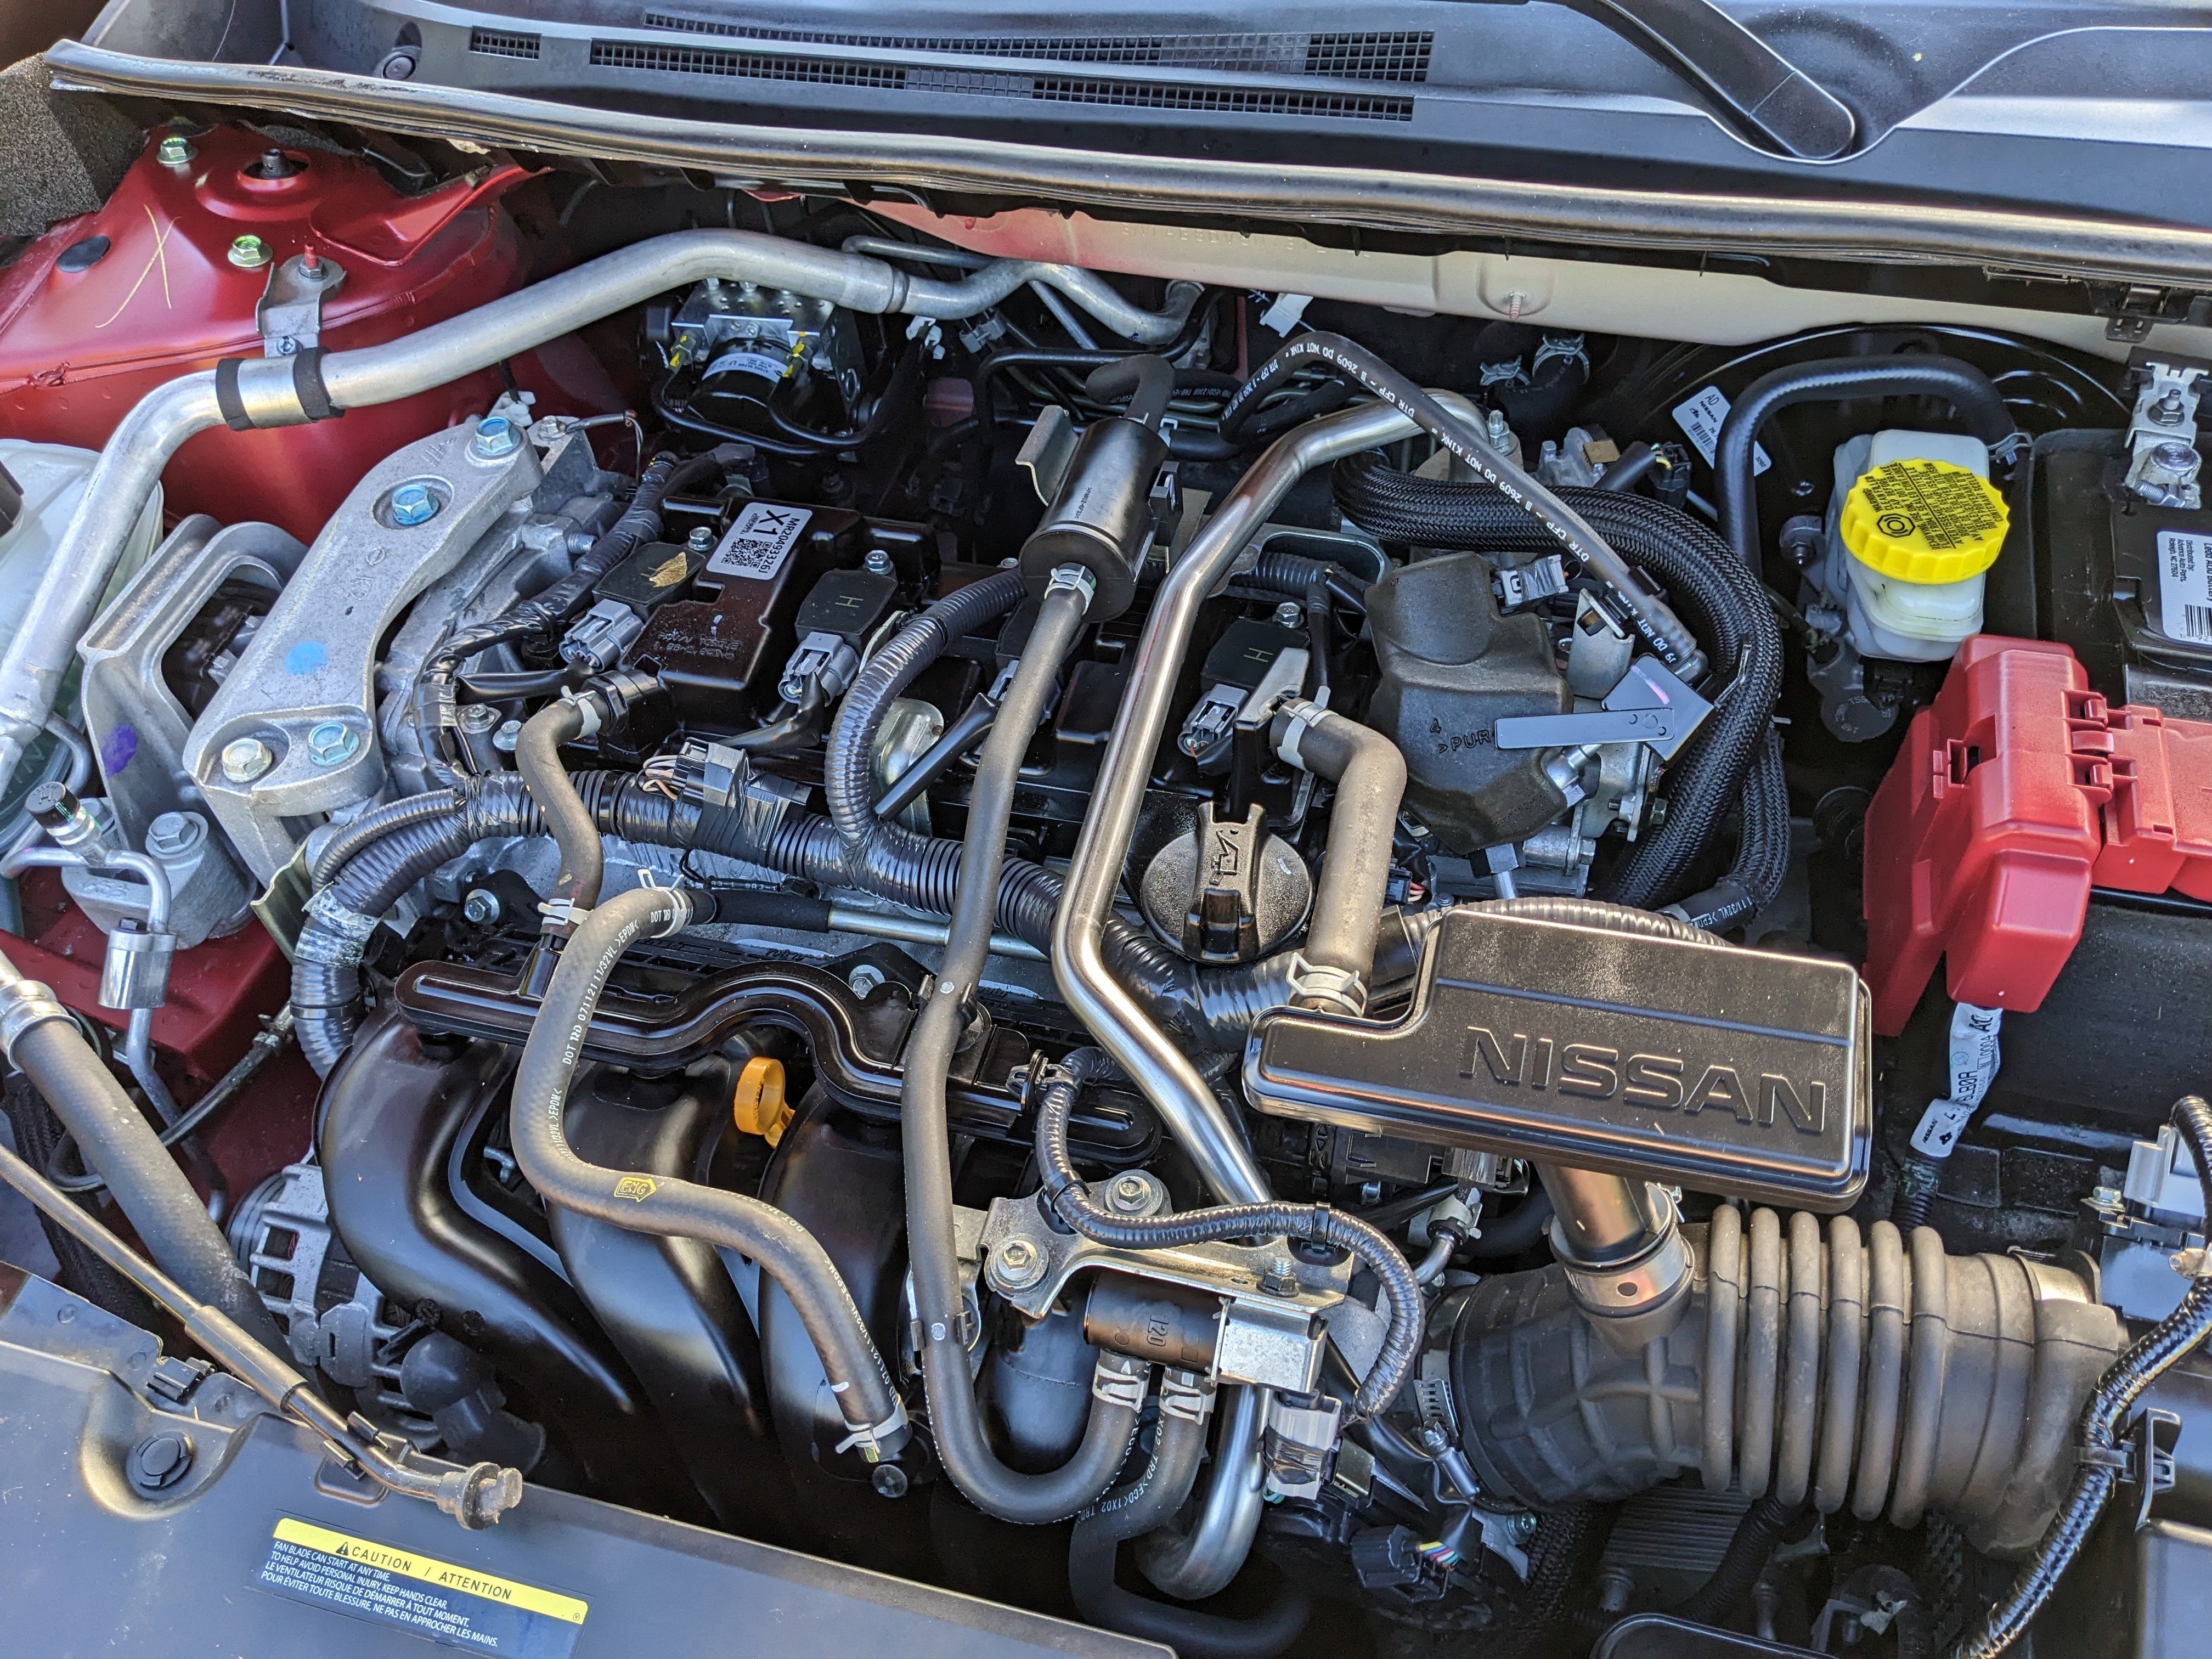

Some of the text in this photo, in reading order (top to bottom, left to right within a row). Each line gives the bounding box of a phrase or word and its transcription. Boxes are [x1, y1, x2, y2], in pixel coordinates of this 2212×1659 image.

[1289, 342, 1304, 357] KINK
[1305, 342, 1321, 354] NOT
[1319, 345, 1338, 360] DO
[1334, 353, 1361, 375] 2609
[1376, 385, 1398, 403] CFP
[1704, 391, 1720, 407] AD
[1699, 400, 1718, 424] NISSAN
[1437, 431, 1466, 455] KINK
[1463, 453, 1485, 472] NOT
[1880, 465, 1898, 482] BRAKE
[1481, 467, 1498, 482] DO
[1497, 479, 1525, 503] 2609
[1876, 477, 1905, 509] CAP BEFORE
[1894, 487, 1908, 498] DOT
[1908, 492, 1927, 512] SEALED
[752, 509, 791, 535] X1
[1910, 512, 1923, 522] USE
[1925, 518, 1940, 532] FROM
[1545, 518, 1569, 540] CFP
[758, 516, 800, 574] MR20493326J
[1567, 539, 1591, 562] DTR
[1935, 533, 1951, 549] FLUID
[1635, 616, 1656, 639] NOT
[1652, 635, 1668, 652] DO
[744, 883, 776, 891] SA3-1
[650, 910, 663, 923] DOT
[561, 1043, 577, 1065] DOT
[576, 982, 599, 1022] 071121
[1459, 1026, 1826, 1135] NISSAN
[1921, 1117, 1938, 1144] NISSAN
[619, 1179, 648, 1195] EMG
[1147, 1315, 1170, 1348] 120
[274, 1541, 391, 1582] FAN BLADE CAN START AT ANY TIME.
[270, 1551, 448, 1609] TO HELP AVOID PERSONAL INJURY, KEEP HANDS CLEAR.
[351, 1546, 411, 1572] CAUTION
[438, 1570, 511, 1600] ATTENTION
[265, 1561, 470, 1627] LE VENTILATEUR RISQUE DE DÉMARRER À TOUT MOMENT.
[261, 1570, 499, 1647] POUR ÉVITER TOUTE BLESSURE, NE PAS EN APPROCHER LES MAINS.
